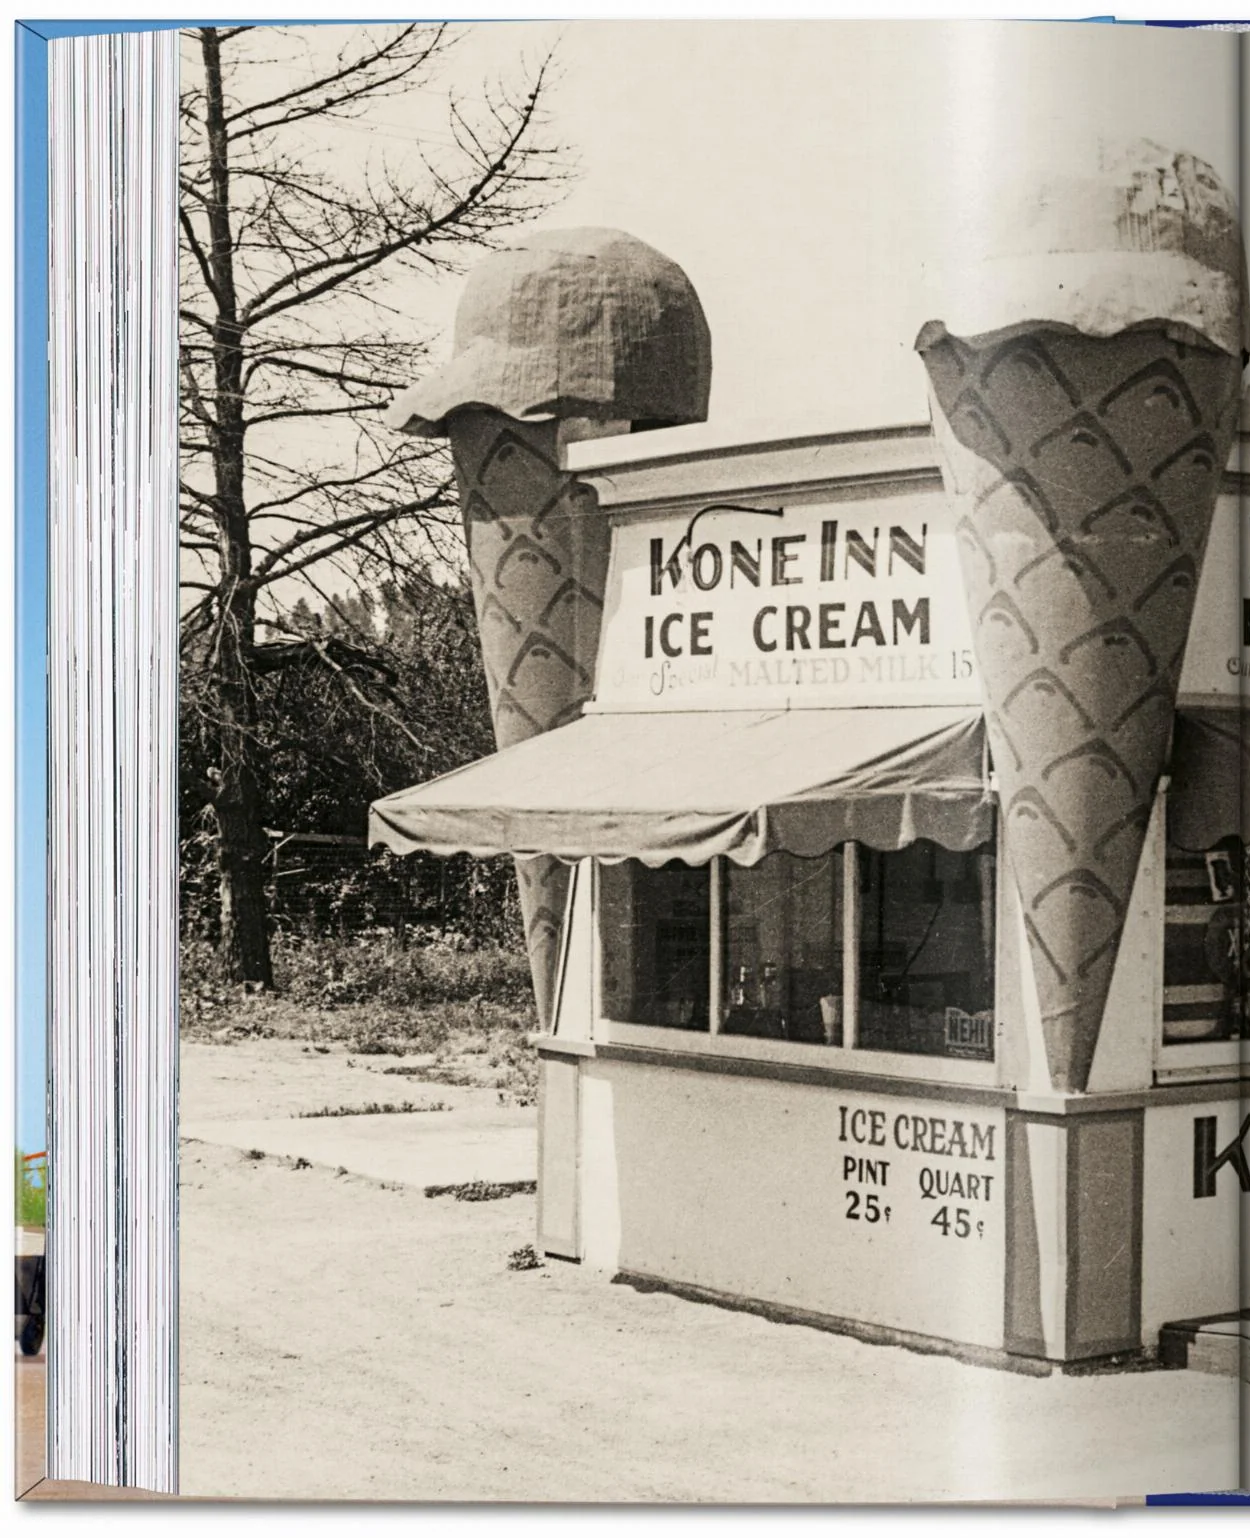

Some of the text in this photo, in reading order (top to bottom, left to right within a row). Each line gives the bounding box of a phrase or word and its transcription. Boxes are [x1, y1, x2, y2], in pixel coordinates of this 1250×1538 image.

[650, 519, 927, 596] KONE INN
[644, 597, 931, 659] ICE CREAM
[728, 654, 851, 687] MALTED
[858, 650, 940, 679] MILK
[949, 1016, 988, 1044] NEHI
[838, 1106, 996, 1161] ICE CREAM
[843, 1156, 994, 1201] PINT QUART
